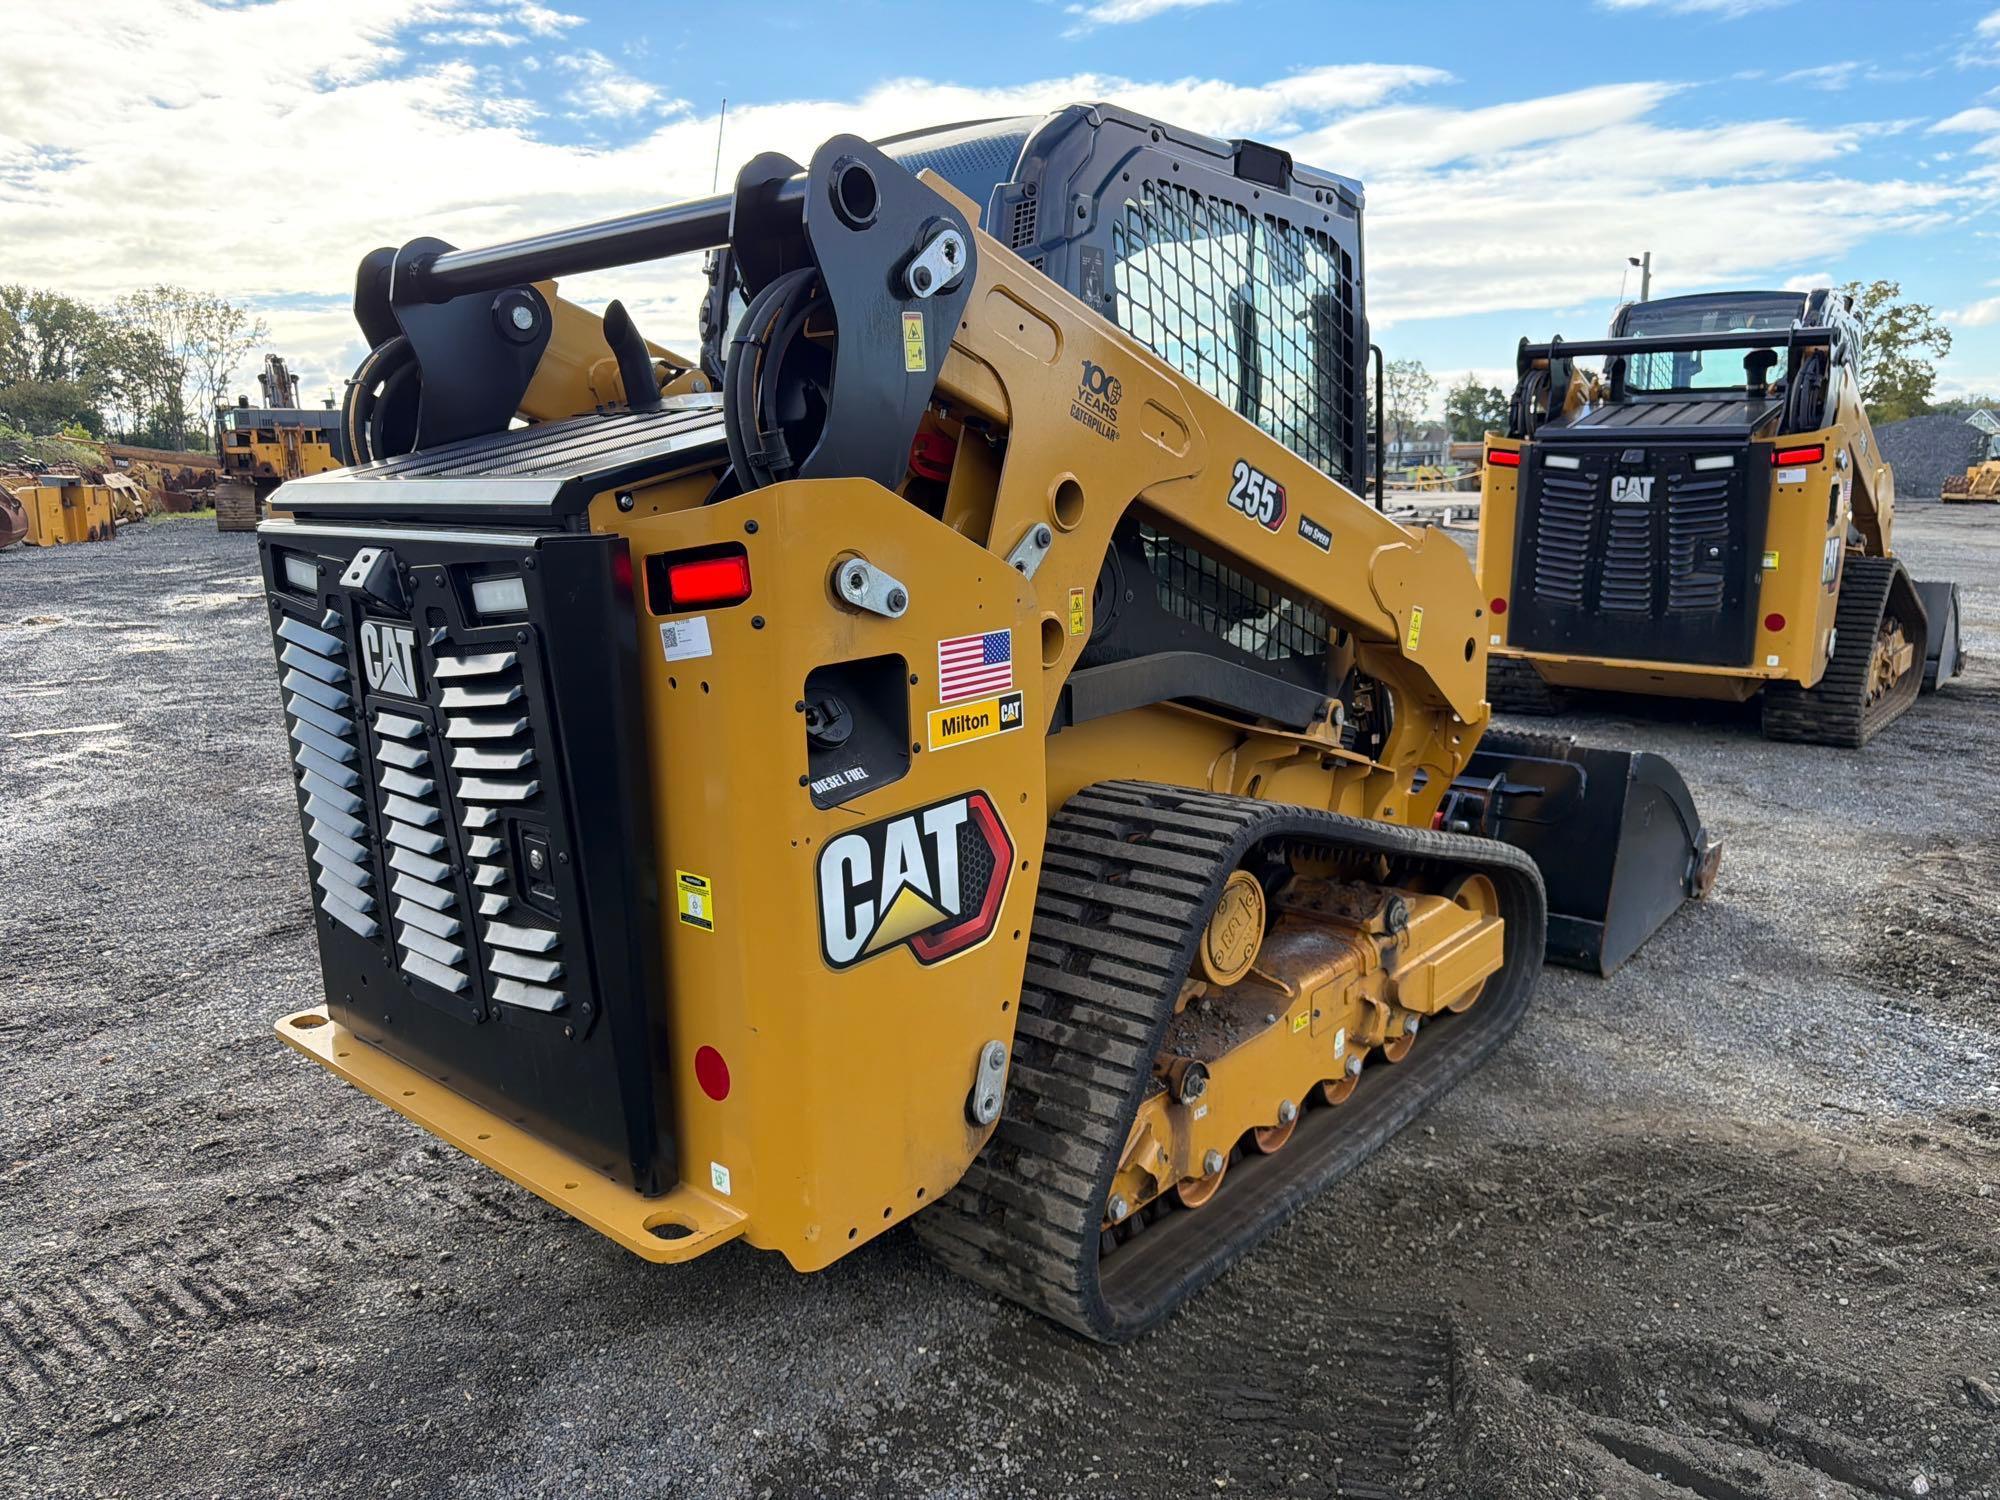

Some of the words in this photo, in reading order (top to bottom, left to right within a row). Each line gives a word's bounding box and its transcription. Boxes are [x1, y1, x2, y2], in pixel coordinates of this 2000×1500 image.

[1077, 386, 1117, 422] YEARS
[1229, 460, 1277, 524] 255
[1610, 475, 1656, 503] CAT
[360, 621, 418, 698] CAT
[941, 712, 989, 738] Milton
[999, 701, 1020, 723] CAT
[810, 773, 845, 796] DIESEL
[844, 766, 869, 785] FUEL
[820, 798, 968, 964] CAT
